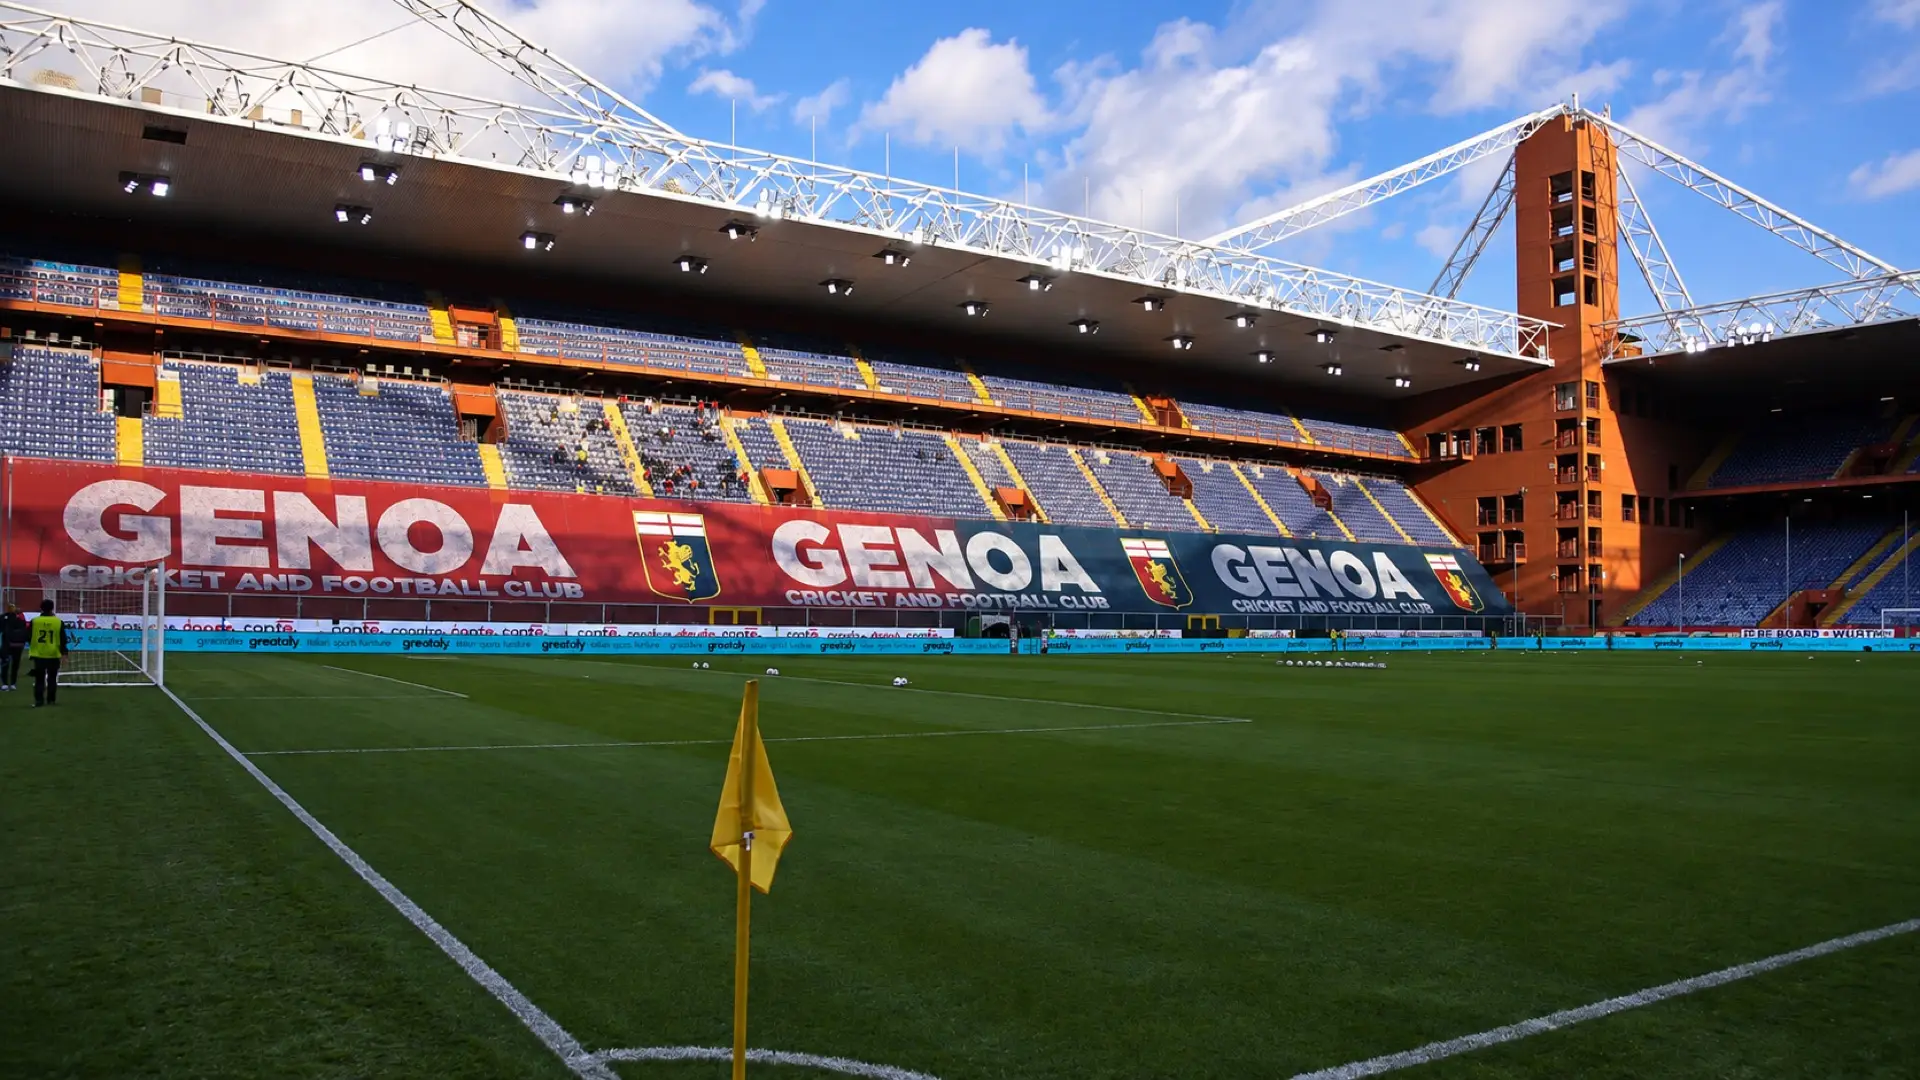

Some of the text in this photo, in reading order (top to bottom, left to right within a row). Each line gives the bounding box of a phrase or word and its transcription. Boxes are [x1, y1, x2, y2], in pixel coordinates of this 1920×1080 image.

[63, 478, 578, 578] GENOA
[771, 519, 1102, 593] GENOA
[59, 563, 584, 599] CRICKET AND FOOTBALL CLUB
[1211, 543, 1425, 600] GENOA
[784, 589, 1111, 610] CRICKET AND FOOTBALL CLUB
[1231, 598, 1435, 615] CRICKET AND FOOTBALL CLUB
[37, 629, 54, 645] 21
[249, 635, 300, 649] greataly
[402, 638, 450, 651] greataly
[541, 638, 586, 652] greataly
